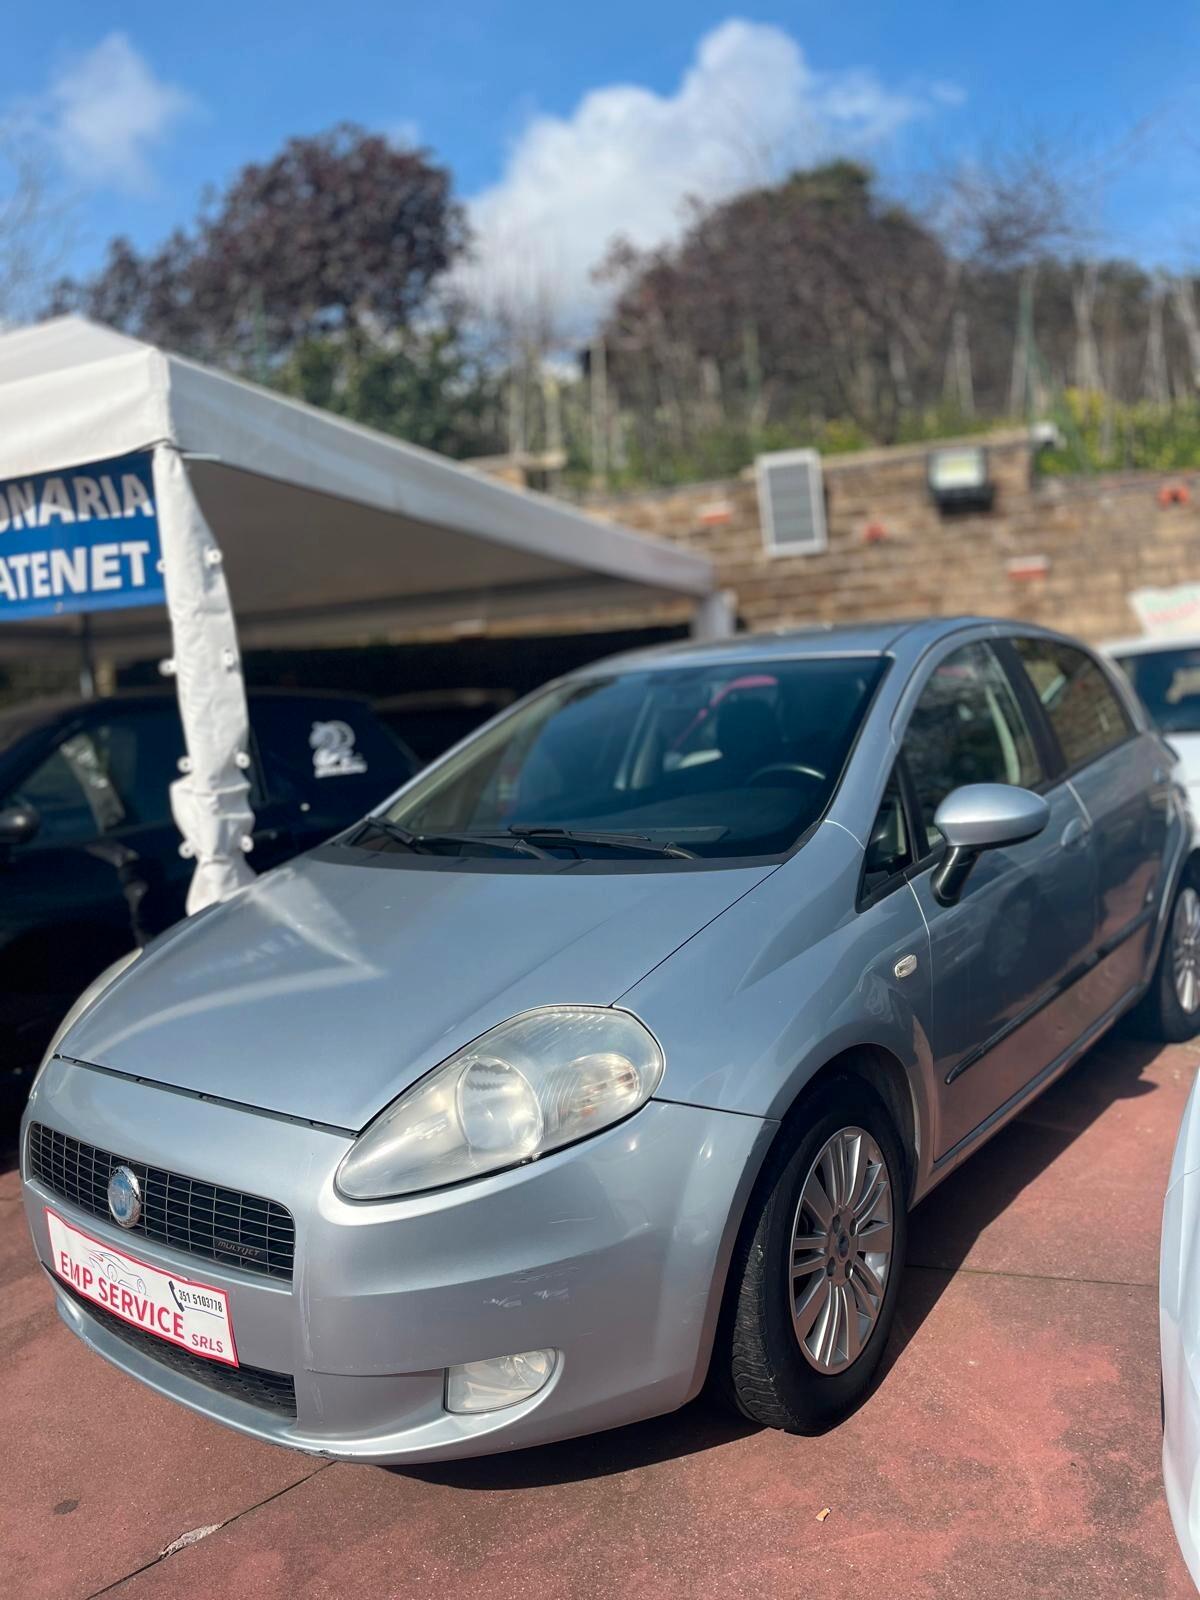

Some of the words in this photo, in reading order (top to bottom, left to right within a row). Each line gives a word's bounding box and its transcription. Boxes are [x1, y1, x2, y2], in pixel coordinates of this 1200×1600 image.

[60, 1251, 94, 1290] EMP
[98, 1276, 186, 1339] SERVICE
[191, 1333, 224, 1354] SRLS
[179, 1289, 191, 1303] 351
